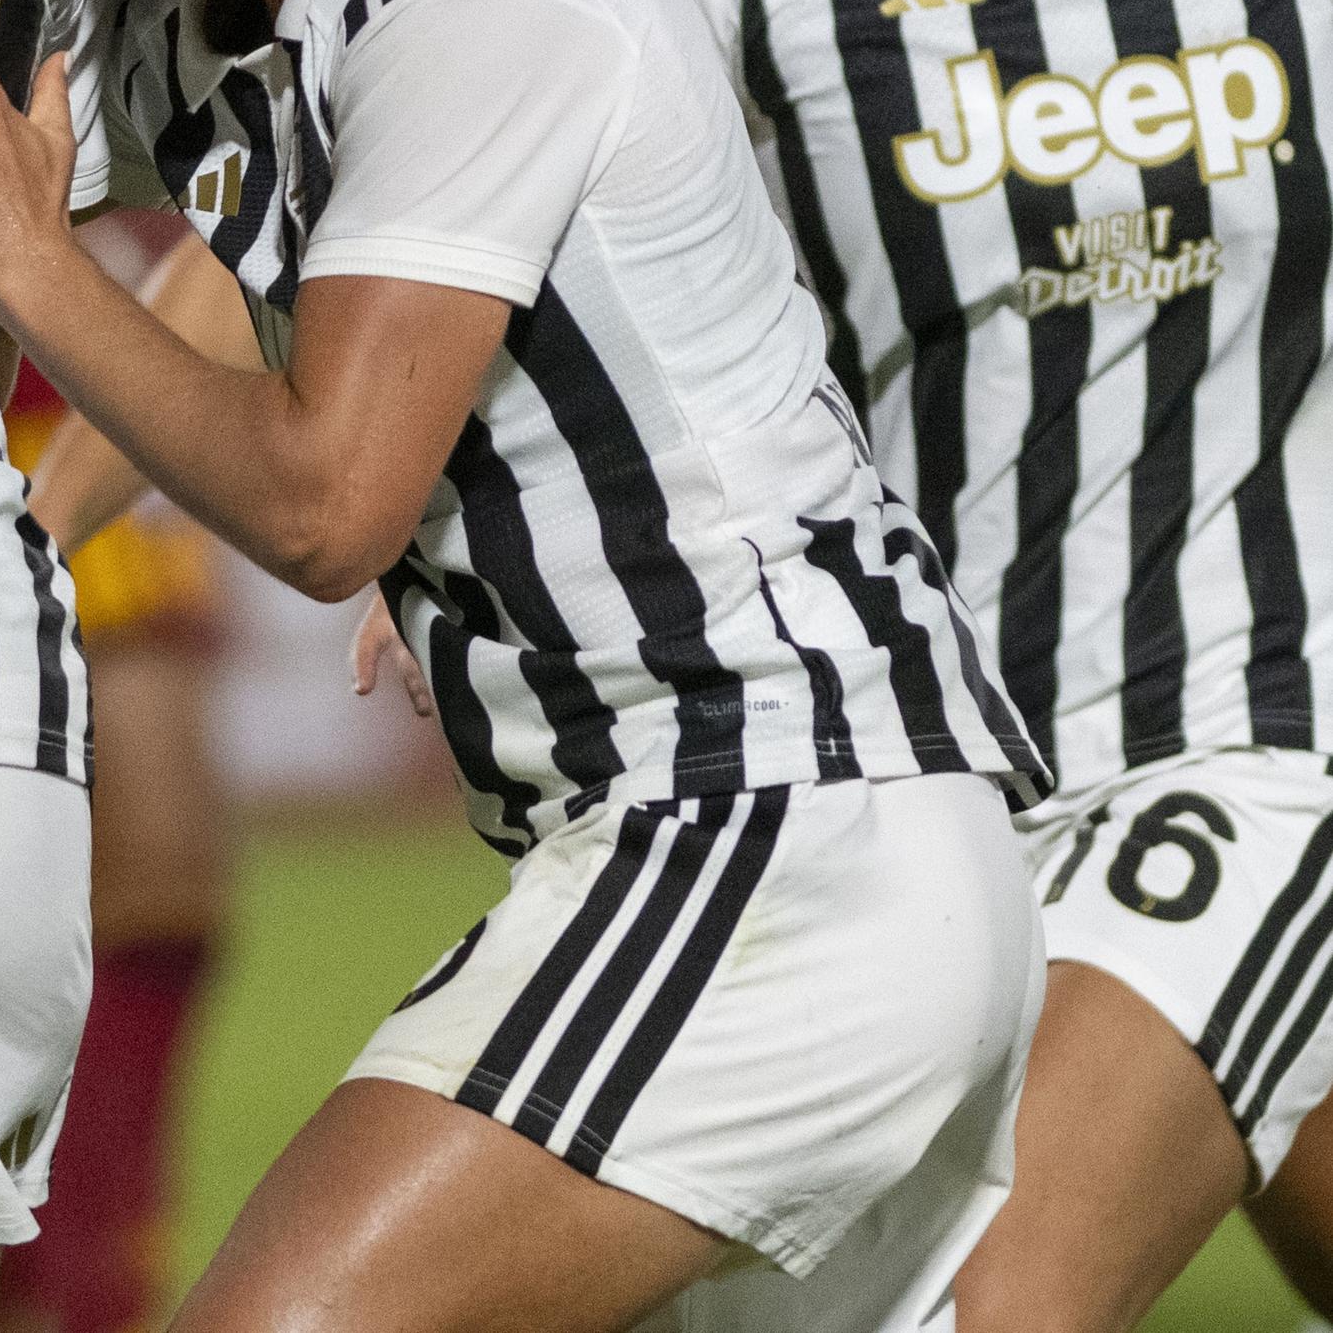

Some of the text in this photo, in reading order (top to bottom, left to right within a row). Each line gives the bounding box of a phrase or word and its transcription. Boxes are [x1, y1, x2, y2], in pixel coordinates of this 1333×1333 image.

[891, 36, 1291, 205] Jeep
[1017, 236, 1223, 321] Detroit
[1053, 205, 1173, 268] VISIT
